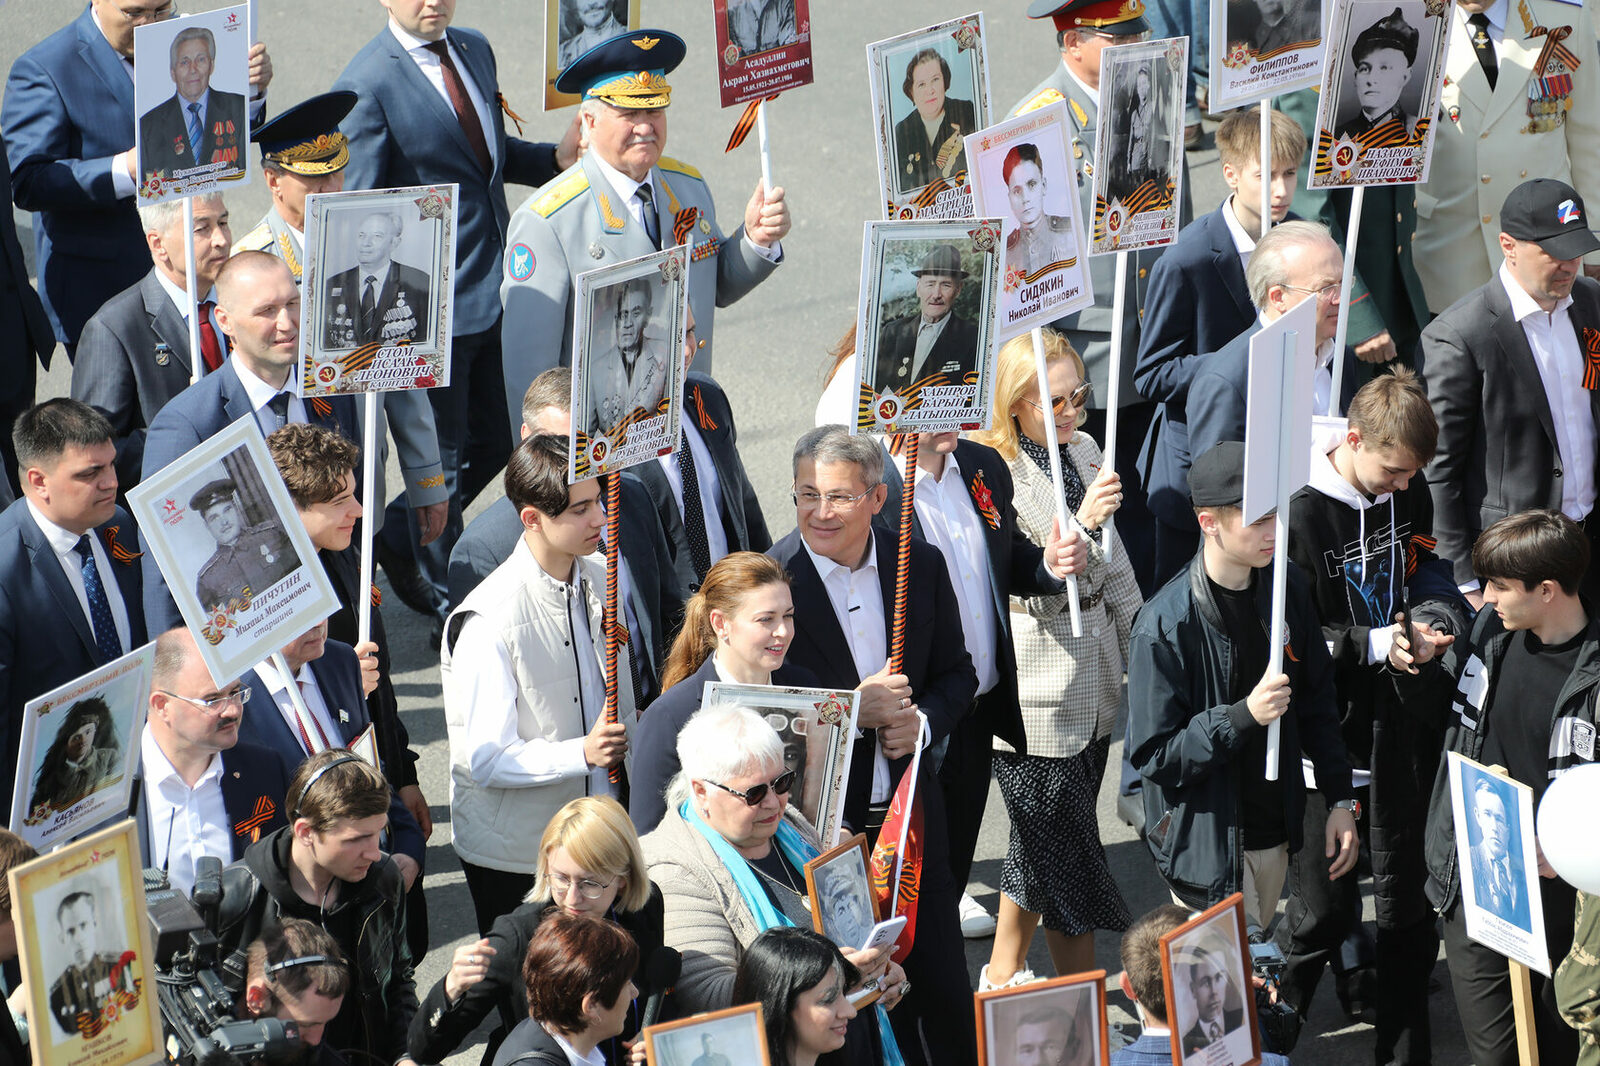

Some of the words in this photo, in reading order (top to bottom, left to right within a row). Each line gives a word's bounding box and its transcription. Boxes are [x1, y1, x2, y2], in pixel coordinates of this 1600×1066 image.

[744, 51, 787, 70] Асадуллин
[1249, 53, 1299, 75] ФИЛИППОВ
[722, 74, 749, 88] Акрам
[1229, 75, 1259, 89] Василий
[1261, 60, 1318, 81] Константинович
[993, 120, 1036, 143] БЕССМЕРТНЫЙ
[1038, 114, 1054, 127] ПОЛК
[1366, 147, 1414, 159] НАЗАРОВ
[1372, 158, 1404, 168] ЕФИМ
[1358, 167, 1416, 179] ИВАНОВИЧ
[936, 187, 967, 203] СТОМ
[1558, 199, 1579, 225] Z
[1020, 273, 1064, 303] СИДЯКИН
[1008, 300, 1041, 322] Николай
[1043, 286, 1079, 308] Иванович
[377, 346, 415, 359] СТОМ
[371, 357, 418, 370] ИСААК
[355, 366, 431, 381] ЛЕОНОВИЧ
[369, 379, 413, 389] КАПИТАН
[920, 386, 976, 397] ХАБИРОВ
[922, 397, 966, 408] БАРЫЙ
[904, 408, 982, 420] ЛАТЫПОВИЧ
[920, 422, 960, 431] РЯДОВОЙ
[626, 428, 661, 446] ИОСИФ
[615, 435, 672, 461] РУБЕНОВИЧ
[252, 572, 301, 612] ПИЧУГИН
[235, 614, 265, 637] Михаил
[265, 581, 312, 617] Максимович
[253, 607, 294, 639] старшина
